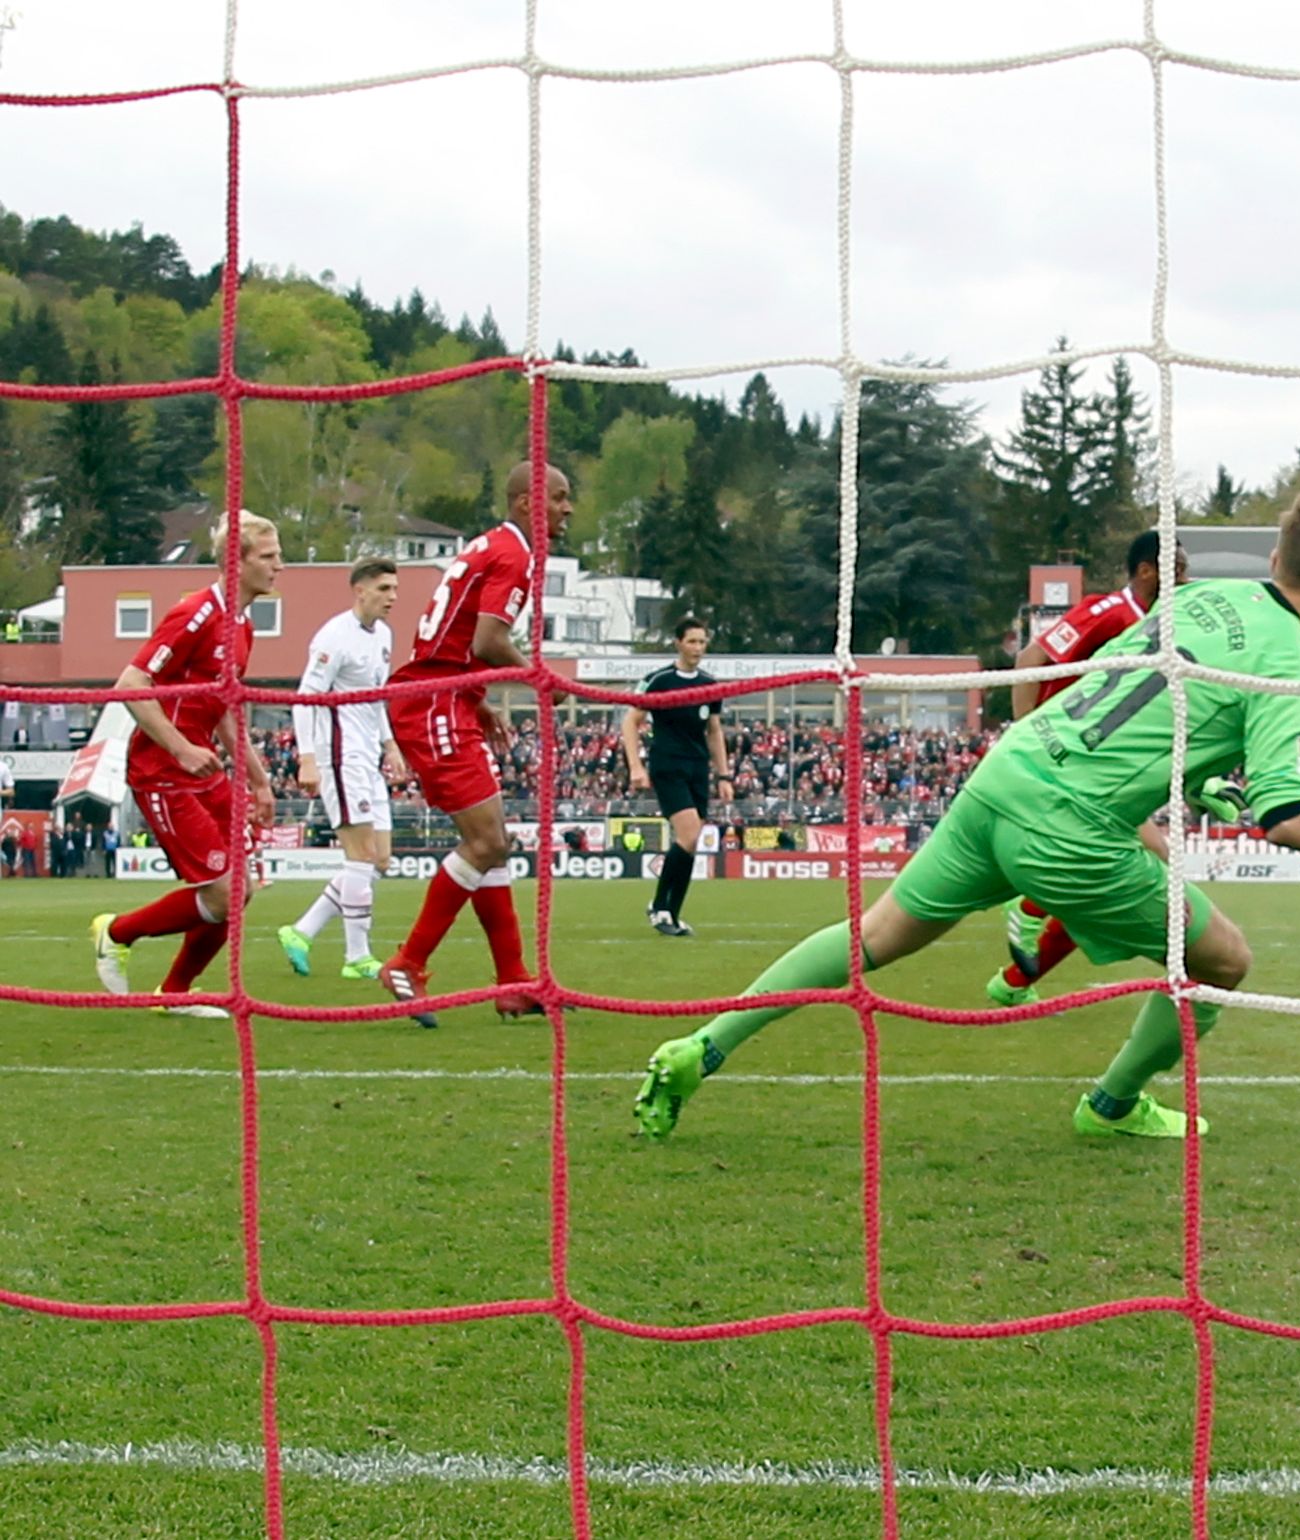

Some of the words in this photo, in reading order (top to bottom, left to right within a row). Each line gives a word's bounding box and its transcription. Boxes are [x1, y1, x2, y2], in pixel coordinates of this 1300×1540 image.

[386, 856, 438, 880] eep
[550, 852, 624, 879] Jeep
[743, 854, 830, 879] brose
